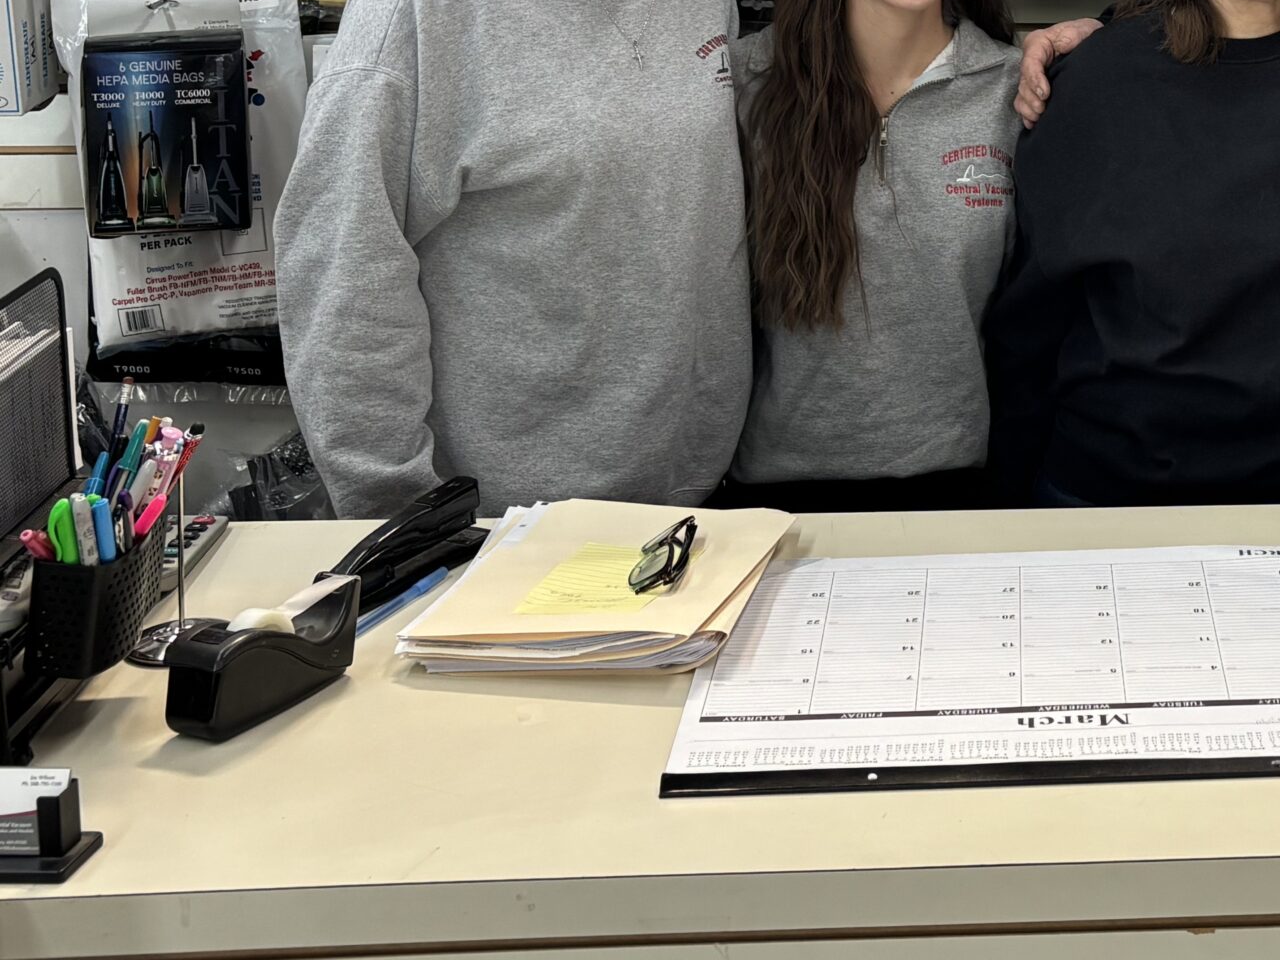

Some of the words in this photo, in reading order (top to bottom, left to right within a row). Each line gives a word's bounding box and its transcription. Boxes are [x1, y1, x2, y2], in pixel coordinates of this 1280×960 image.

[129, 60, 183, 71] GENUINE
[97, 75, 129, 87] HEPA
[132, 73, 170, 86] MEDIA
[173, 71, 205, 83] BAGS
[92, 93, 125, 101] T3000
[175, 89, 210, 98] TC6000
[205, 54, 240, 224] TITAN
[140, 240, 161, 251] PER
[164, 236, 192, 248] PACK
[113, 365, 150, 373] T9000
[1017, 713, 1132, 728] March
